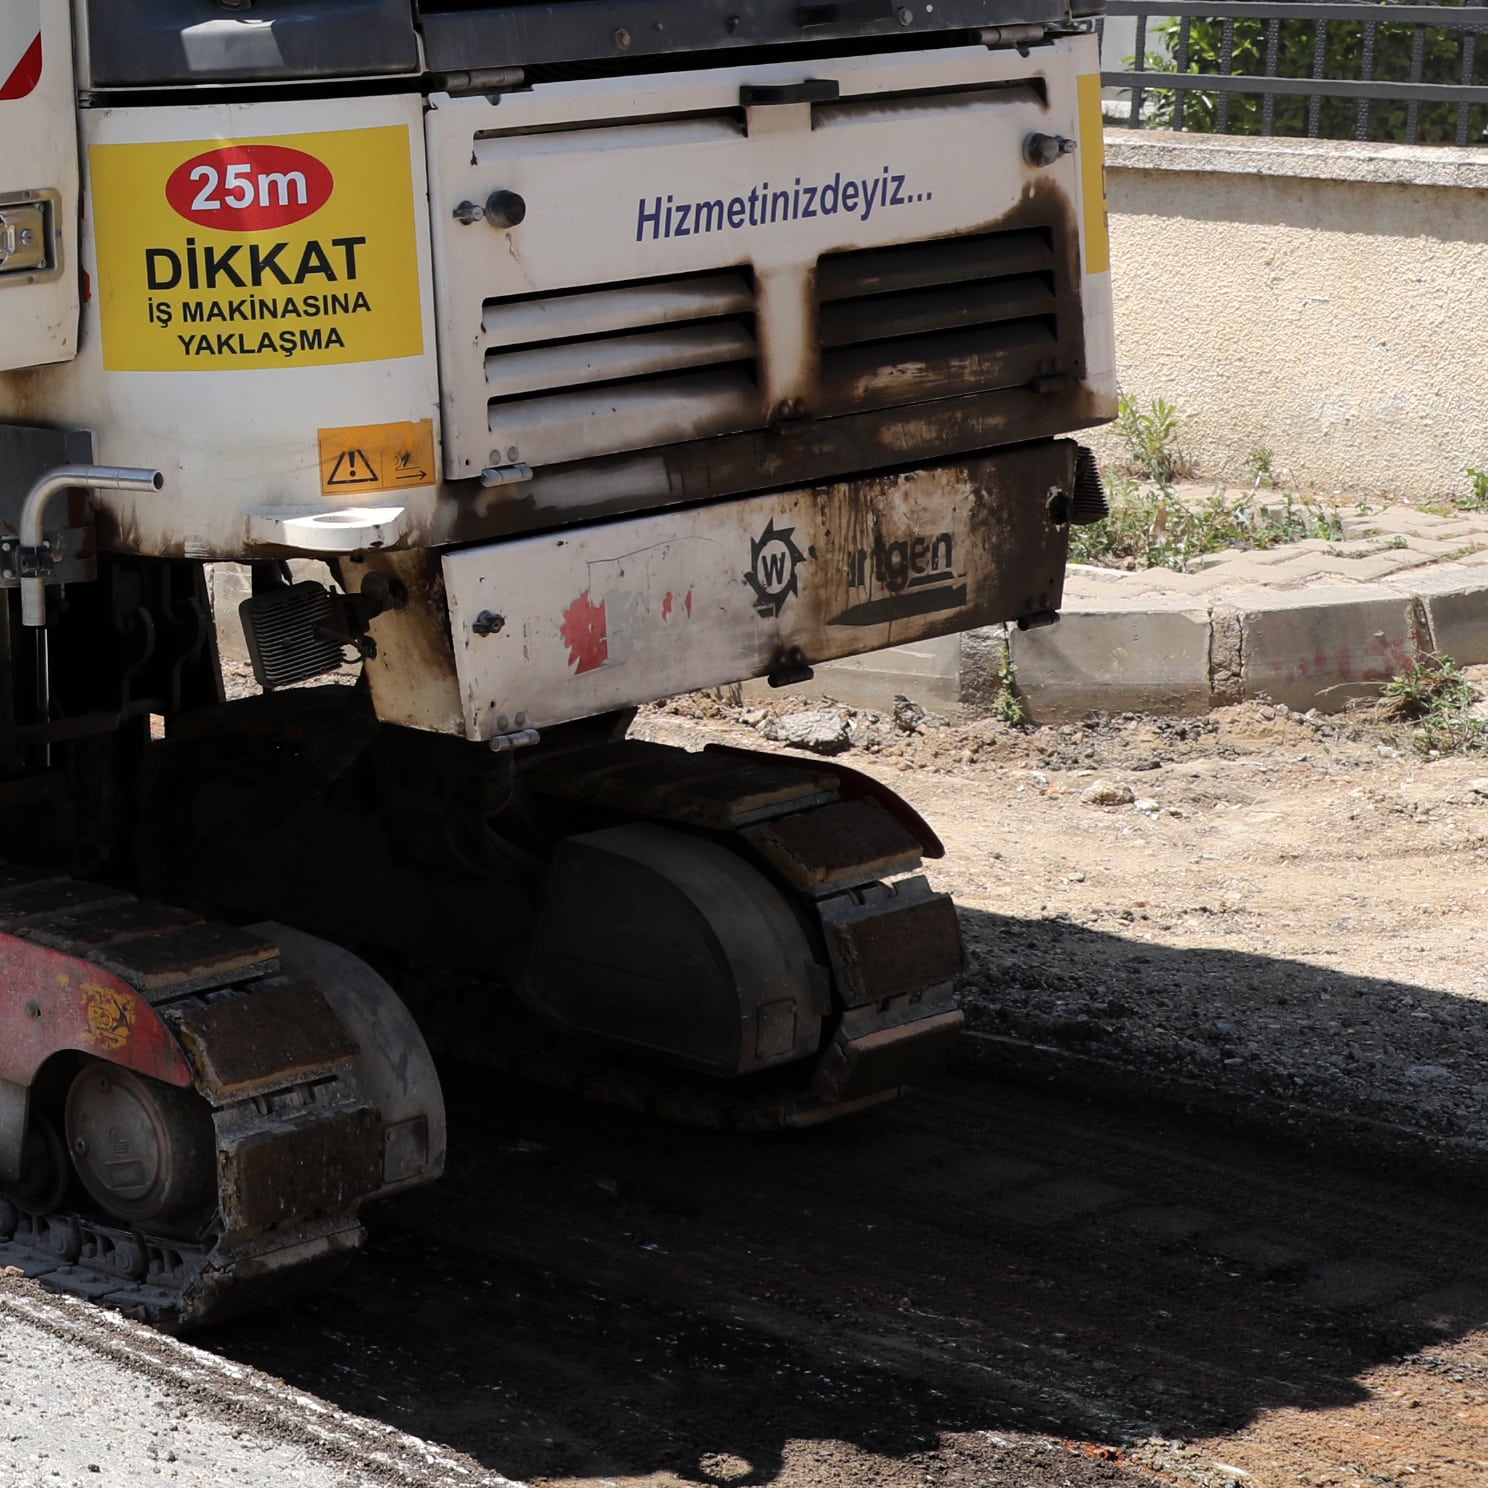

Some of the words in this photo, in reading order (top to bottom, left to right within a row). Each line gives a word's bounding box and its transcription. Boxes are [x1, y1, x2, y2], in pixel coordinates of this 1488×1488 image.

[189, 163, 308, 211] 25m
[636, 166, 933, 241] Hizmetinizdeyiz...
[145, 237, 366, 291] DİKKAT
[148, 297, 173, 328] İŞ
[182, 291, 372, 323] MAKİNASINA
[178, 327, 346, 357] YAKLAŞMA
